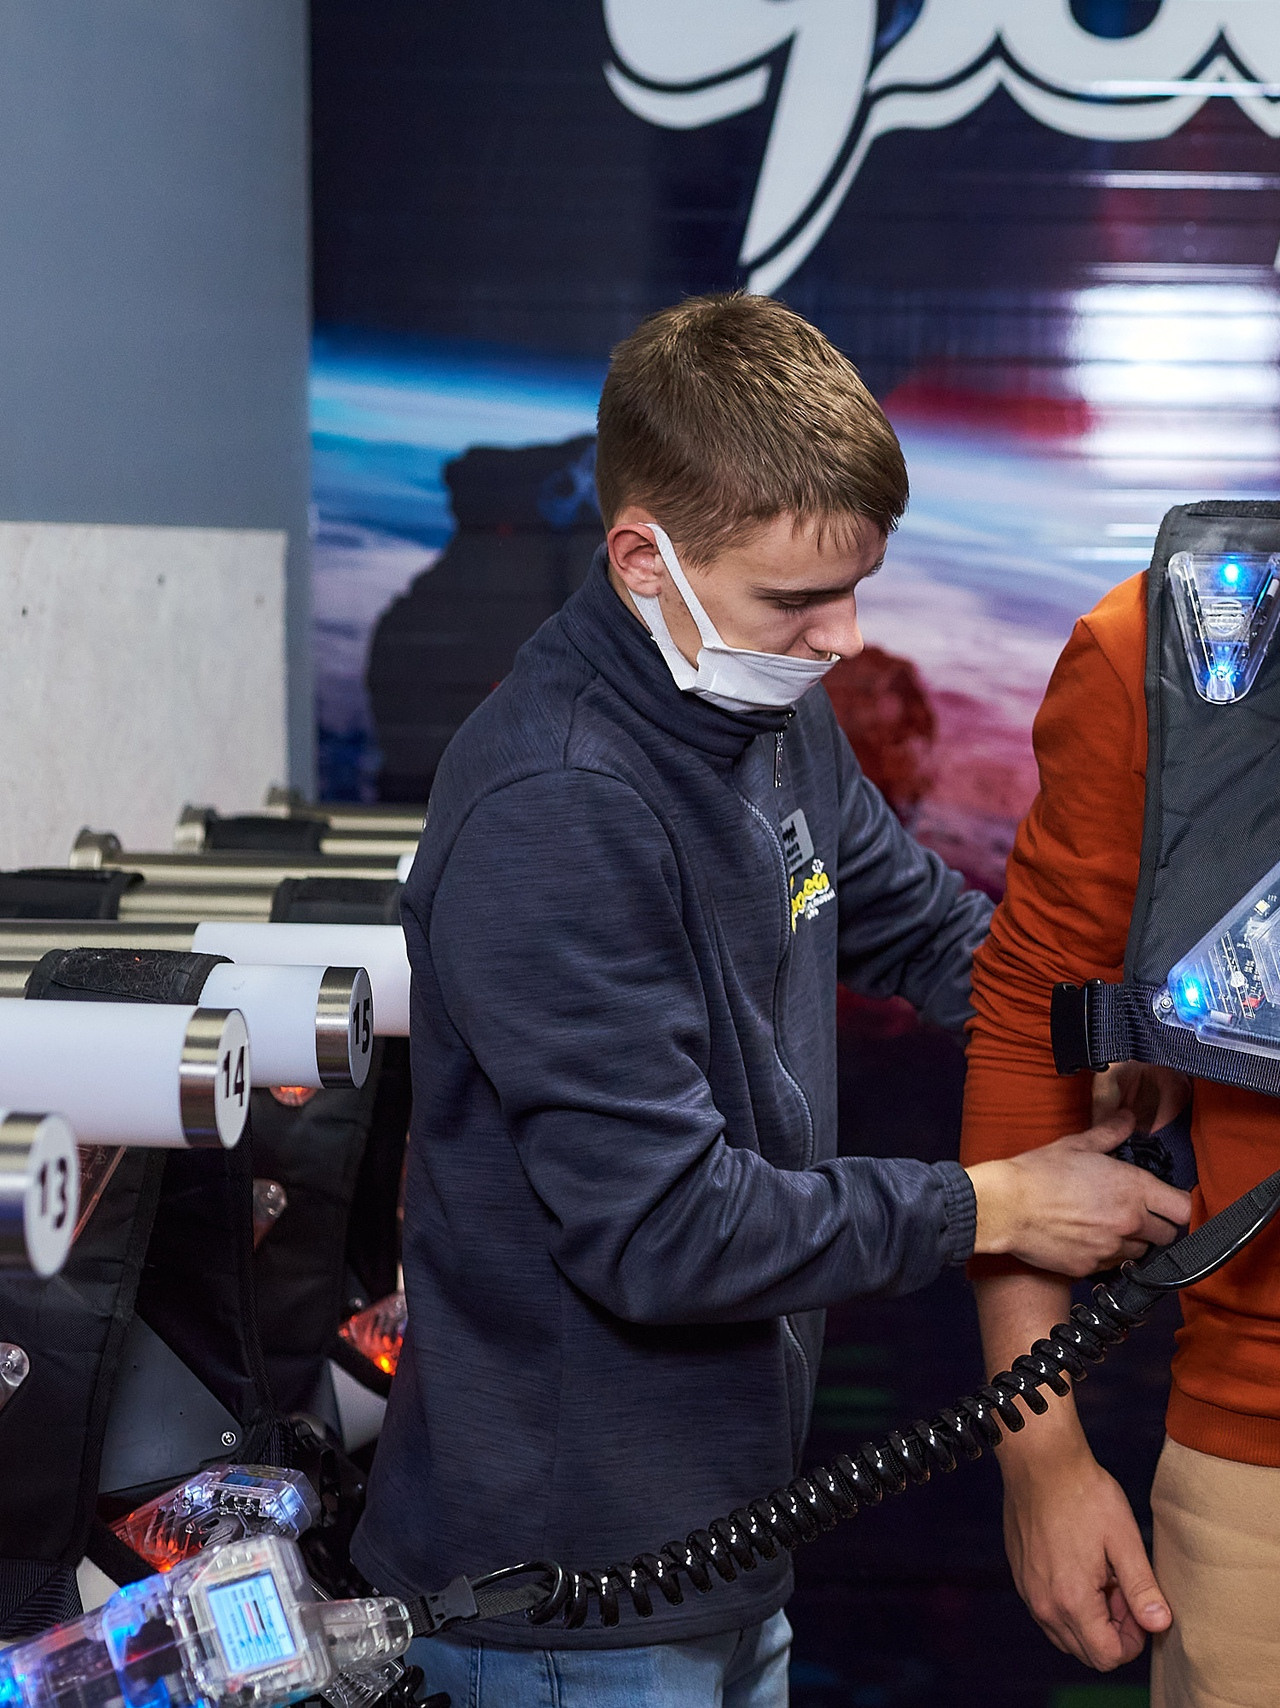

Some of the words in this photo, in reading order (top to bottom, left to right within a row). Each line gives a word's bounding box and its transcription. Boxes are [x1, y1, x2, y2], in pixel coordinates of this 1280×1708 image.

[352, 998, 372, 1054] 15
[221, 1045, 247, 1108] 14
[36, 1156, 70, 1231] 13
